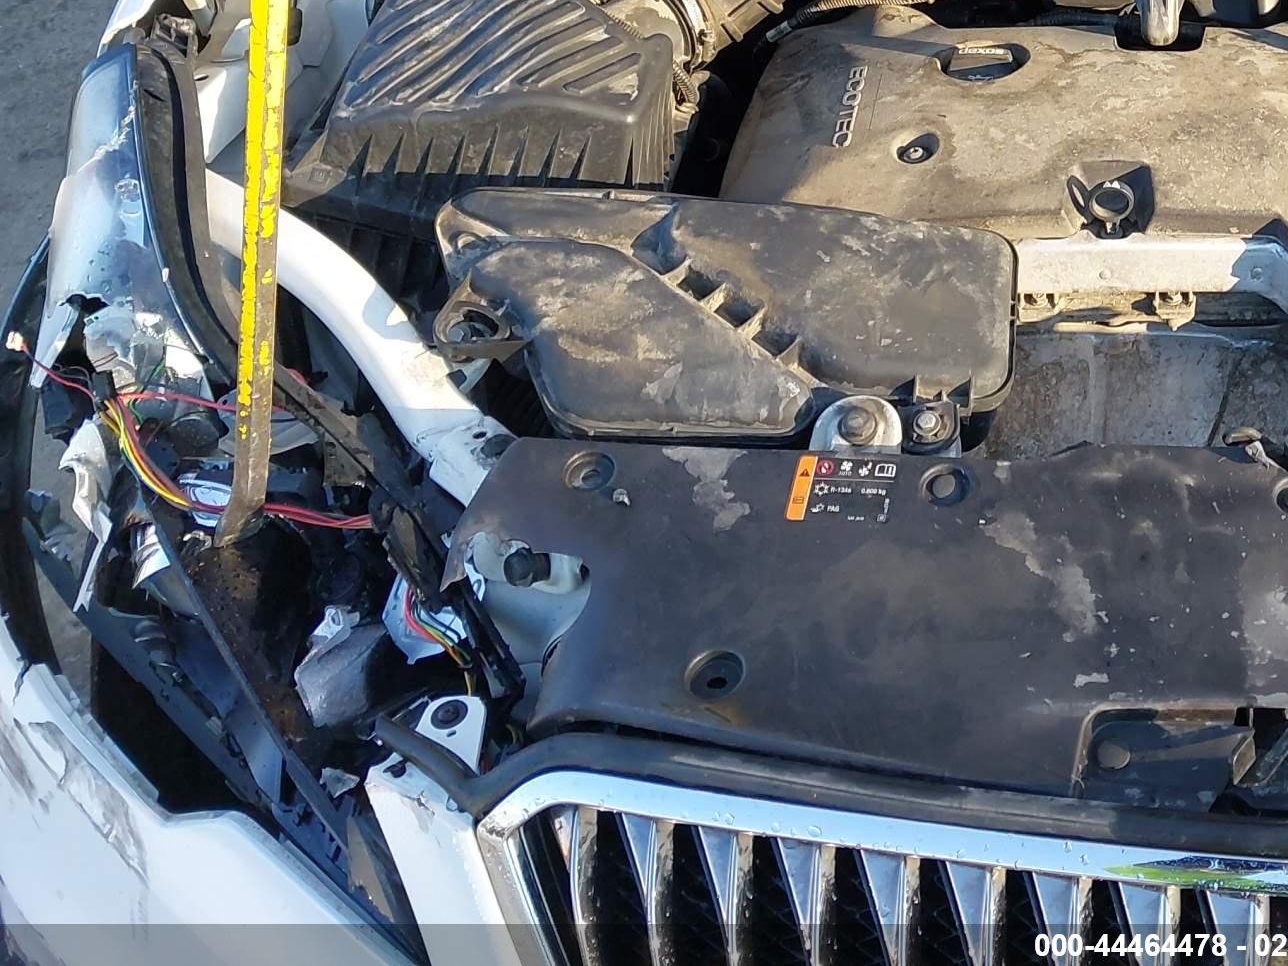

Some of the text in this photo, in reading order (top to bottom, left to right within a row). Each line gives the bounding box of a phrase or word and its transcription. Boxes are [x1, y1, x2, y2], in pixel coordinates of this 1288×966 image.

[958, 46, 1004, 55] dexos
[832, 65, 868, 149] ECOTEC
[826, 505, 840, 513] PAG
